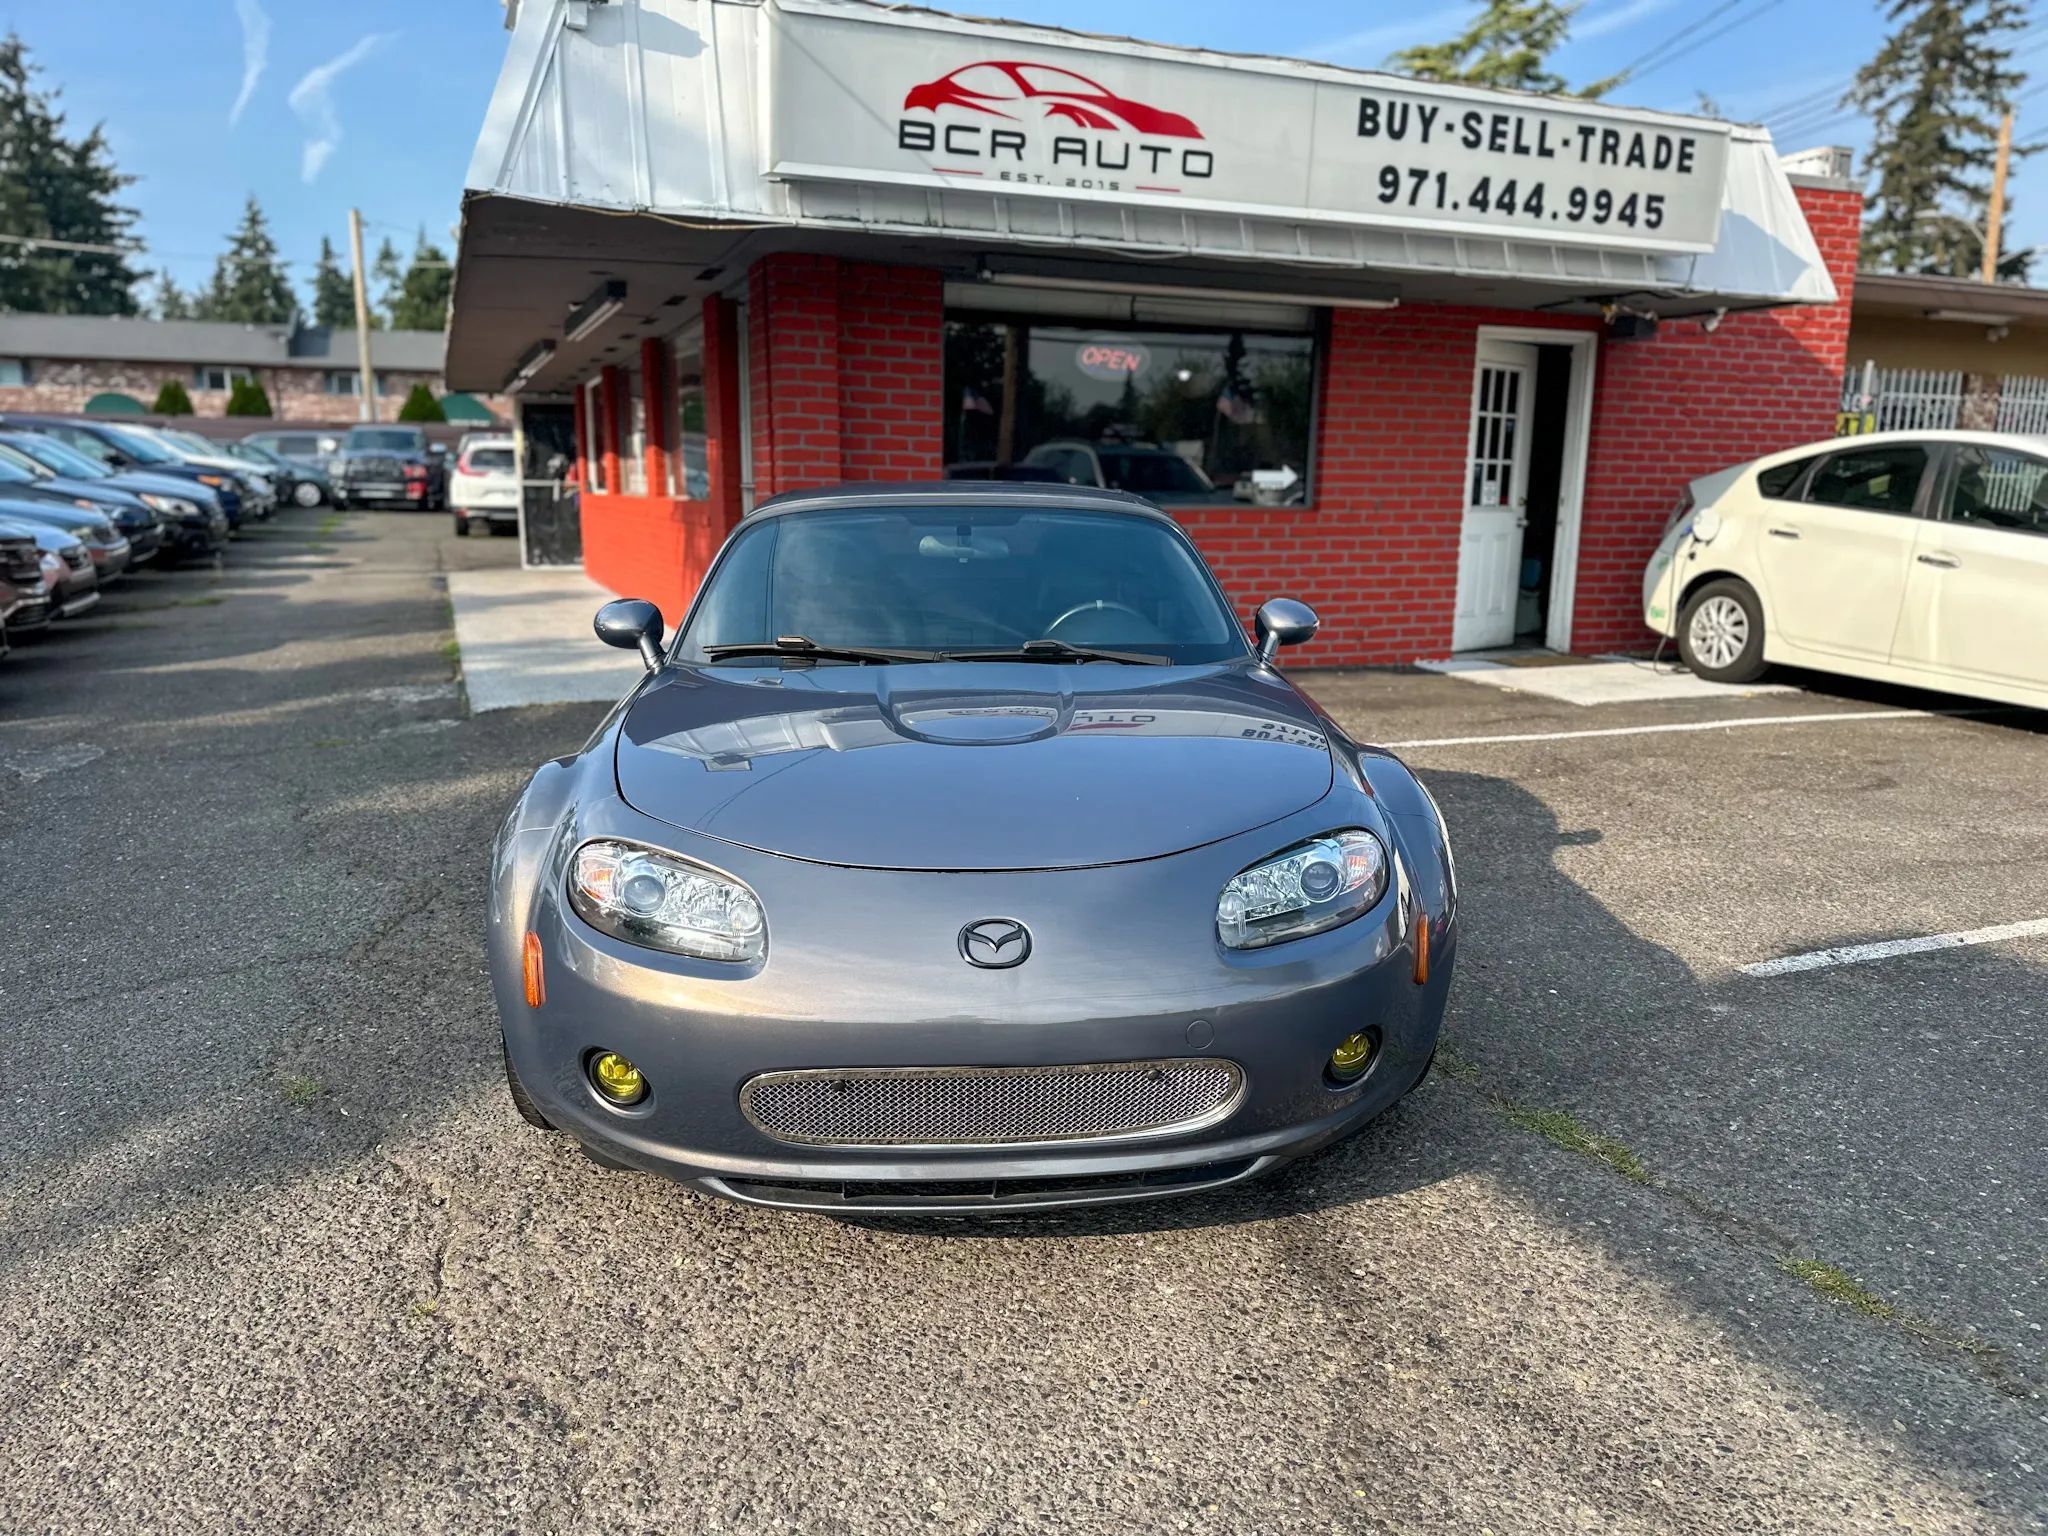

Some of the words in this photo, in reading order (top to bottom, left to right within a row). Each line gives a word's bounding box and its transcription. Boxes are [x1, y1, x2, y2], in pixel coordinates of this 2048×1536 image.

[899, 119, 1026, 161] BCR
[1053, 136, 1213, 178] AUTO
[1000, 171, 1051, 186] EST.
[1065, 178, 1120, 191] 2015
[1377, 165, 1666, 229] 971.444.9945
[1082, 346, 1140, 372] OPEN
